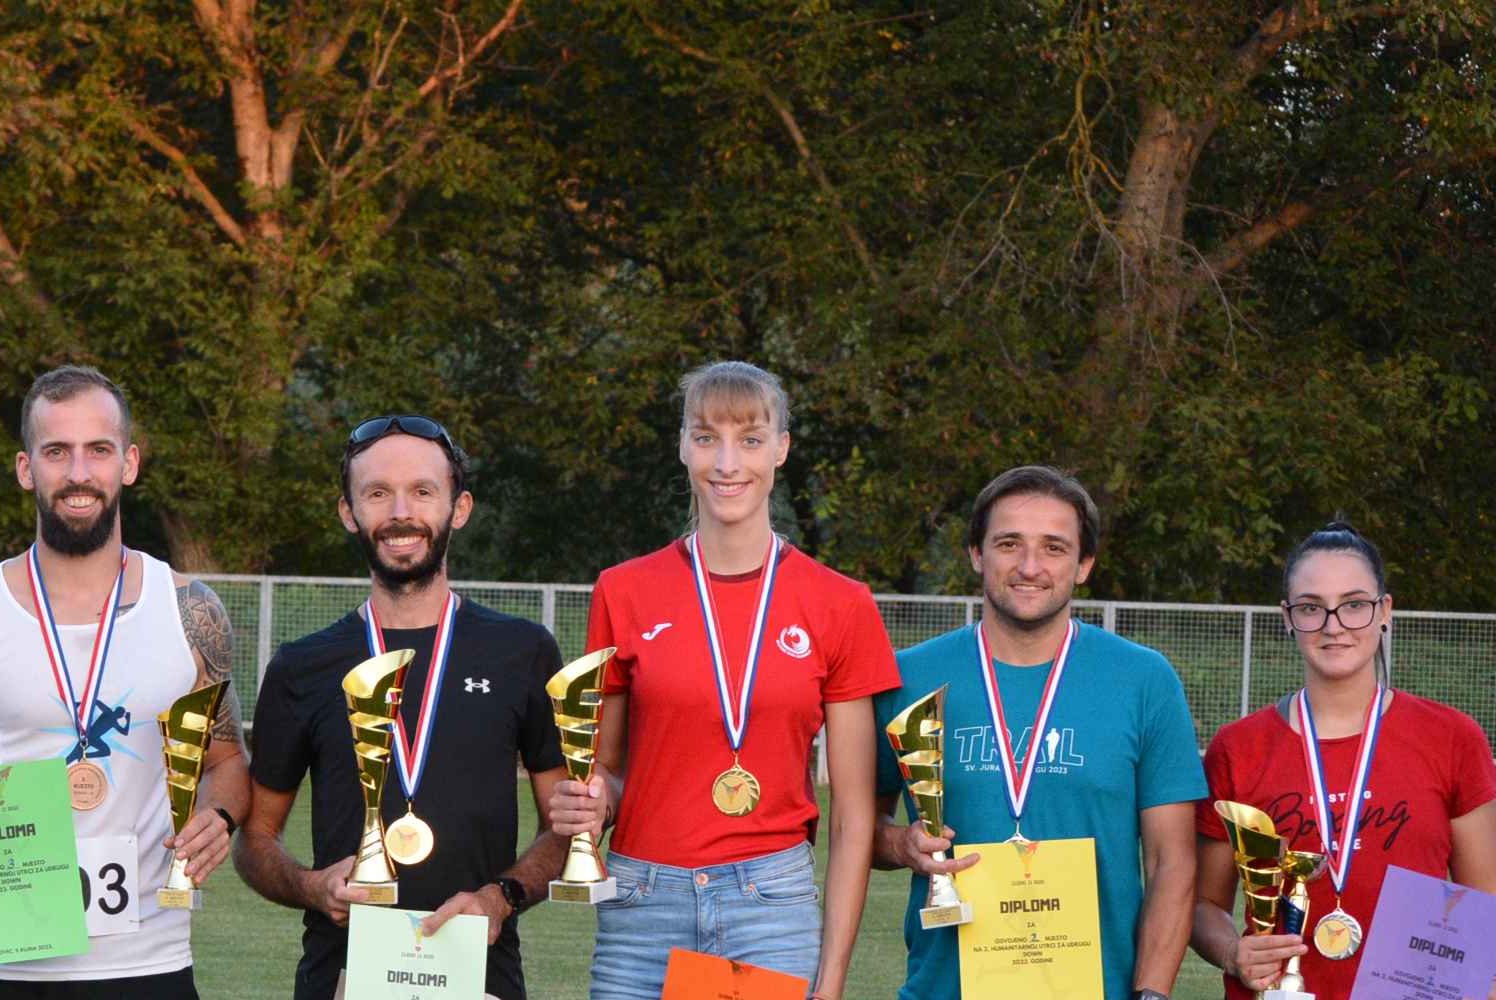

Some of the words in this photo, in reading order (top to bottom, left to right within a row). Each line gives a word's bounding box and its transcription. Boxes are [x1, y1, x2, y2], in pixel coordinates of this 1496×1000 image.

[1000, 898, 1060, 914] DIPLOMA
[1409, 936, 1465, 964] DIPLOMA
[387, 970, 447, 988] DIPLOMA
